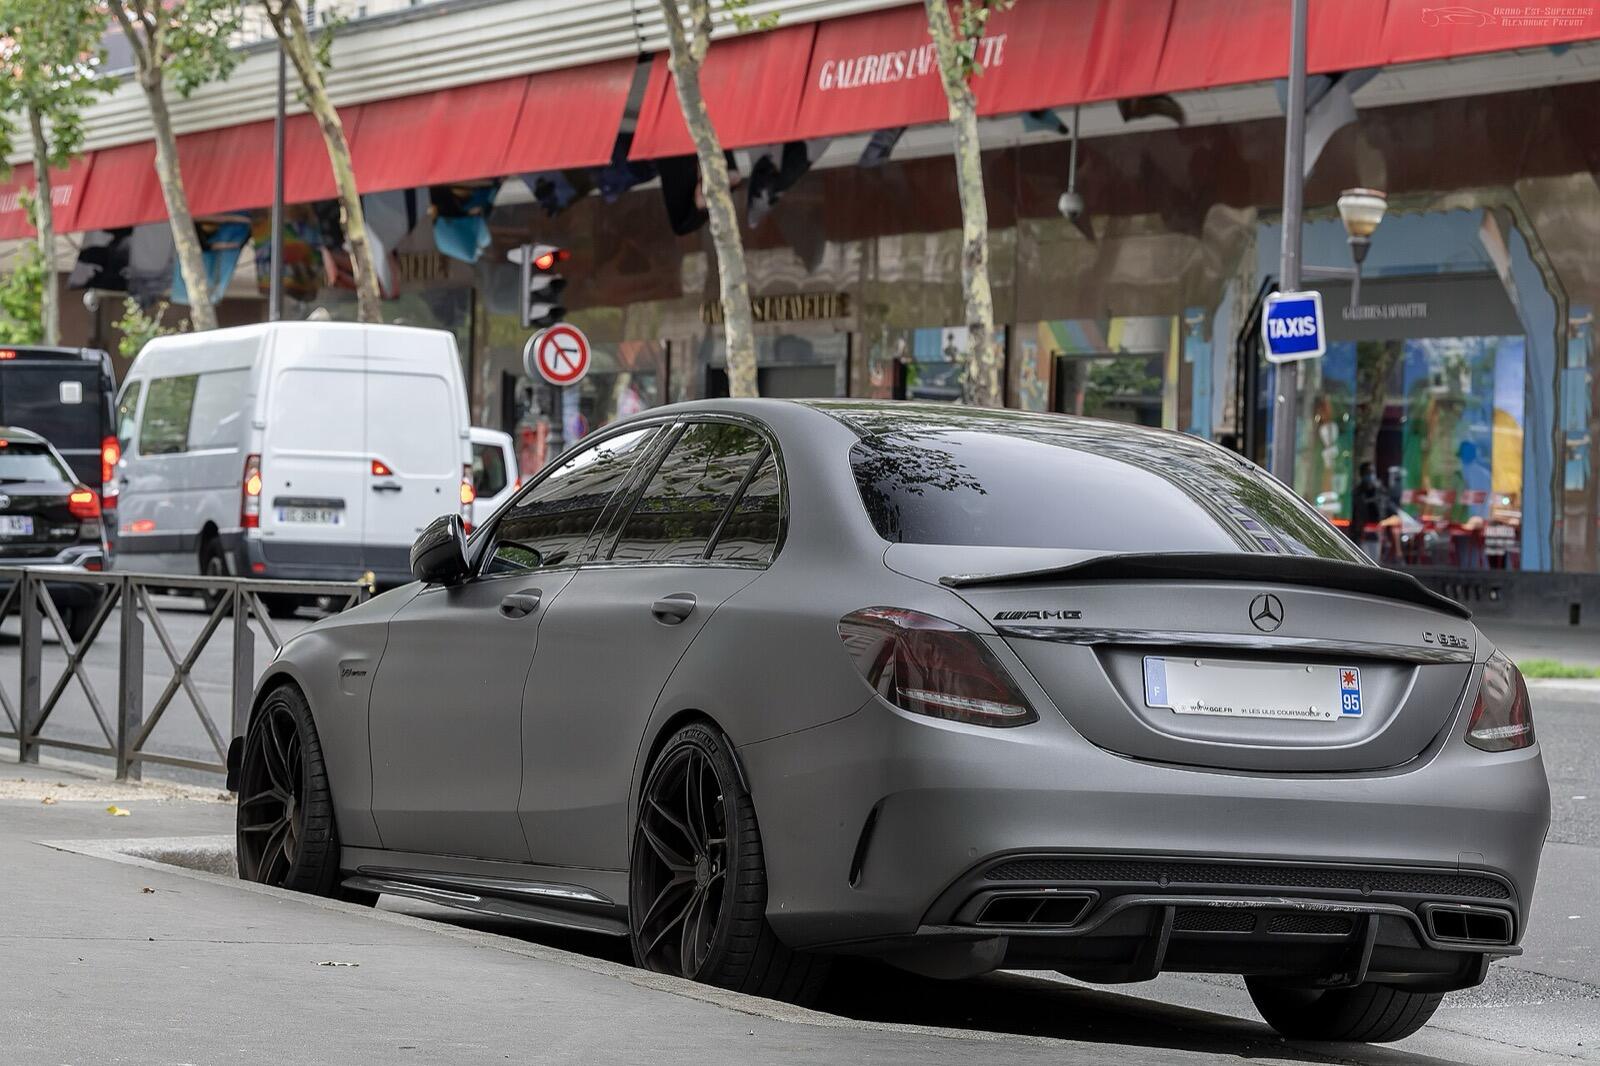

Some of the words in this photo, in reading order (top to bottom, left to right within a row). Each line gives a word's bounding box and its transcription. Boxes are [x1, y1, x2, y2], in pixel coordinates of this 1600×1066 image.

[819, 50, 906, 91] GALERIES
[1267, 315, 1316, 339] TAXIS
[1020, 610, 1082, 620] AMG
[1153, 686, 1161, 697] F
[1343, 693, 1360, 711] 95
